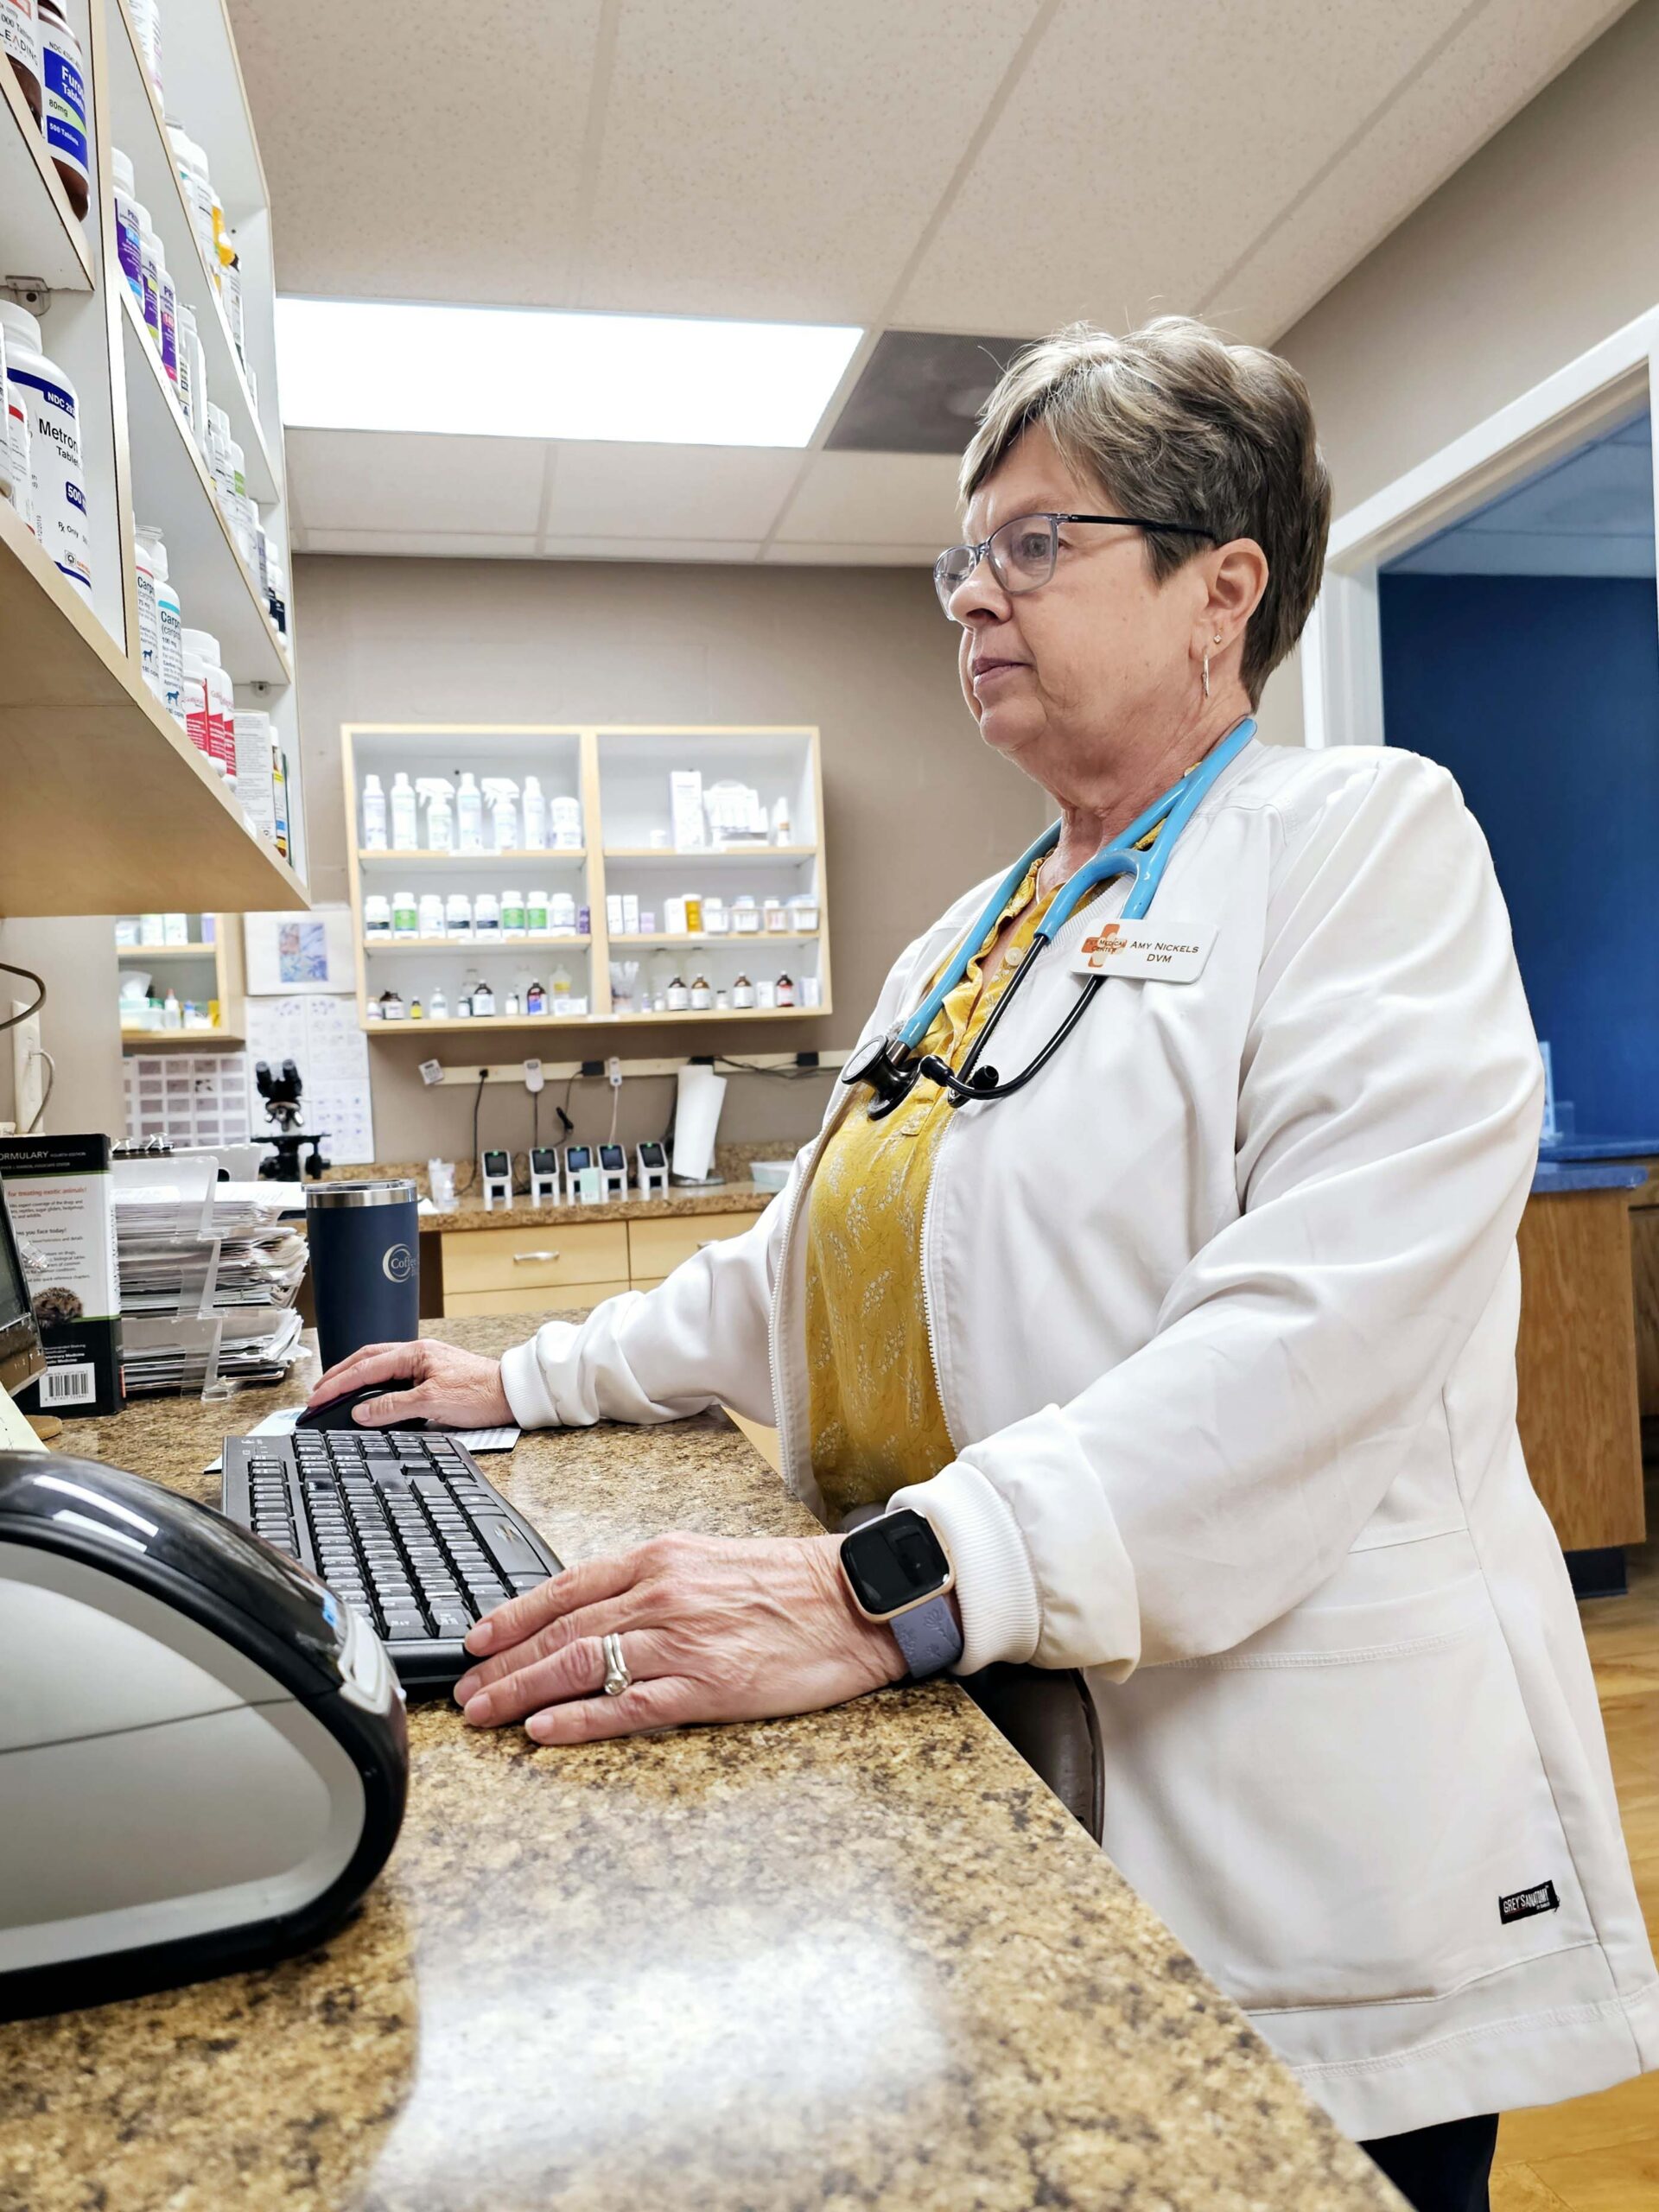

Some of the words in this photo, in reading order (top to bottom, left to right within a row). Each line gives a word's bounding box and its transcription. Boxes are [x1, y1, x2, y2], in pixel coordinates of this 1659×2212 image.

[48, 99, 68, 118] 80mg
[48, 391, 65, 408] NDC
[1147, 953, 1173, 963] DVM
